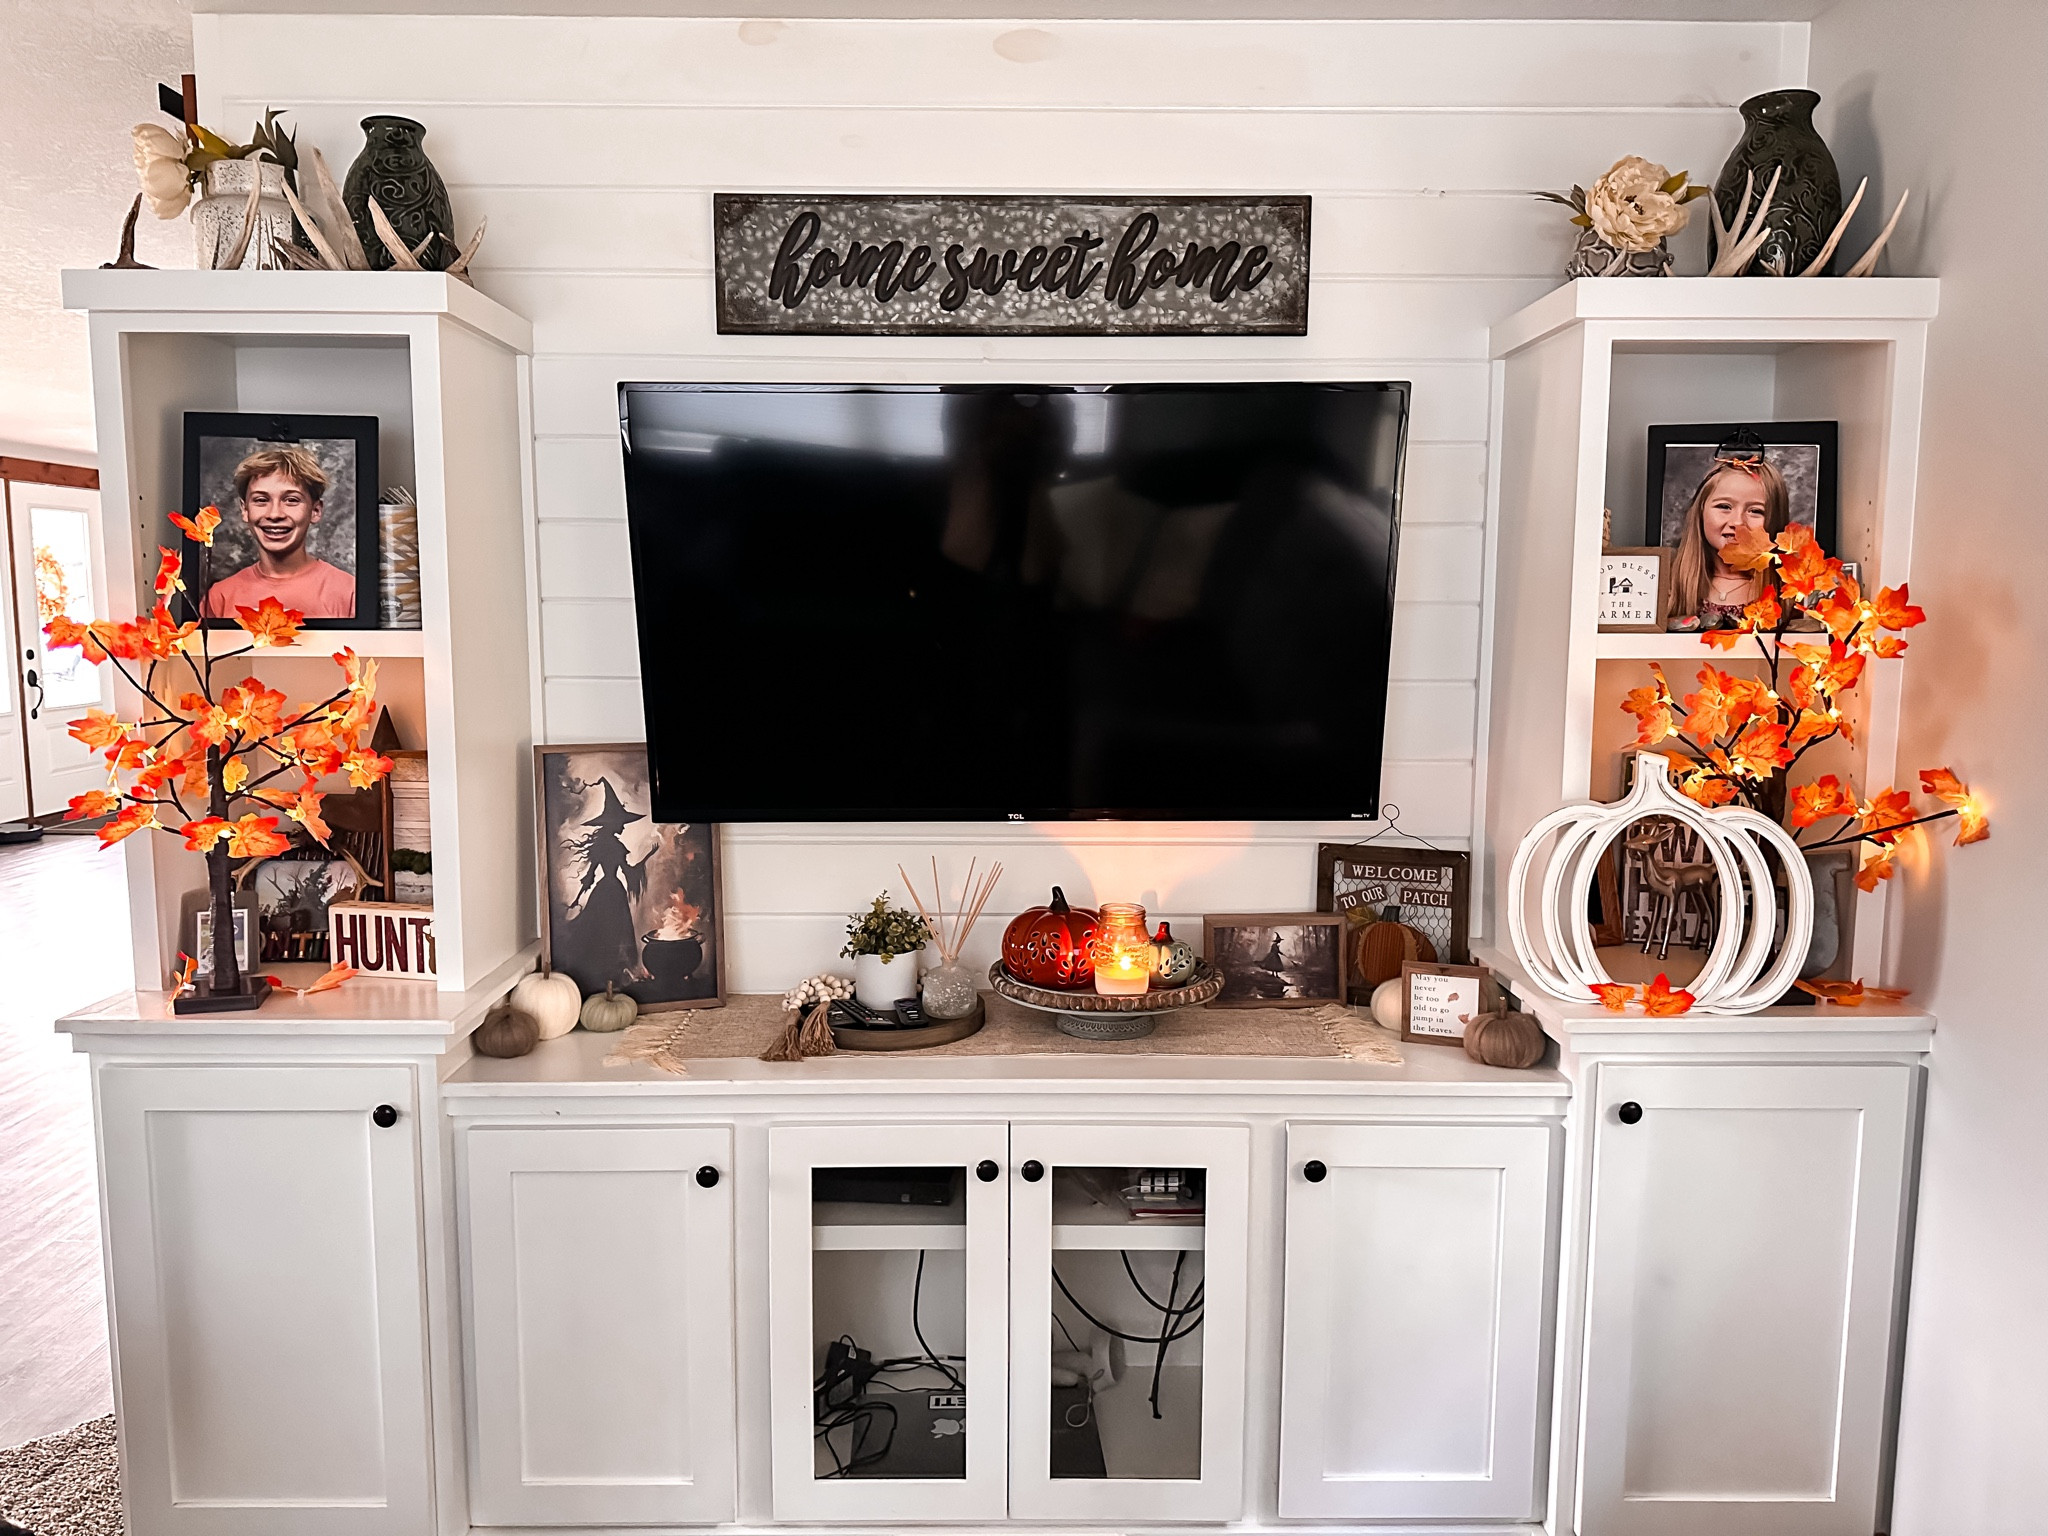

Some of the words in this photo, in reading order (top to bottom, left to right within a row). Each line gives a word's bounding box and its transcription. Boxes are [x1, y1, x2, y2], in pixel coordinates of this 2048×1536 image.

[767, 211, 936, 310] home
[939, 228, 1104, 312] sweet
[1102, 211, 1274, 310] home
[1621, 562, 1656, 580] BLESS
[1352, 864, 1438, 882] WELCOME
[1340, 894, 1357, 910] TO
[1361, 886, 1385, 903] OUR
[1403, 890, 1448, 906] PATCH
[1414, 973, 1430, 983] May
[1413, 993, 1424, 1001] be
[1426, 995, 1440, 1003] too
[1412, 1014, 1434, 1024] jump
[1412, 1023, 1426, 1032] the
